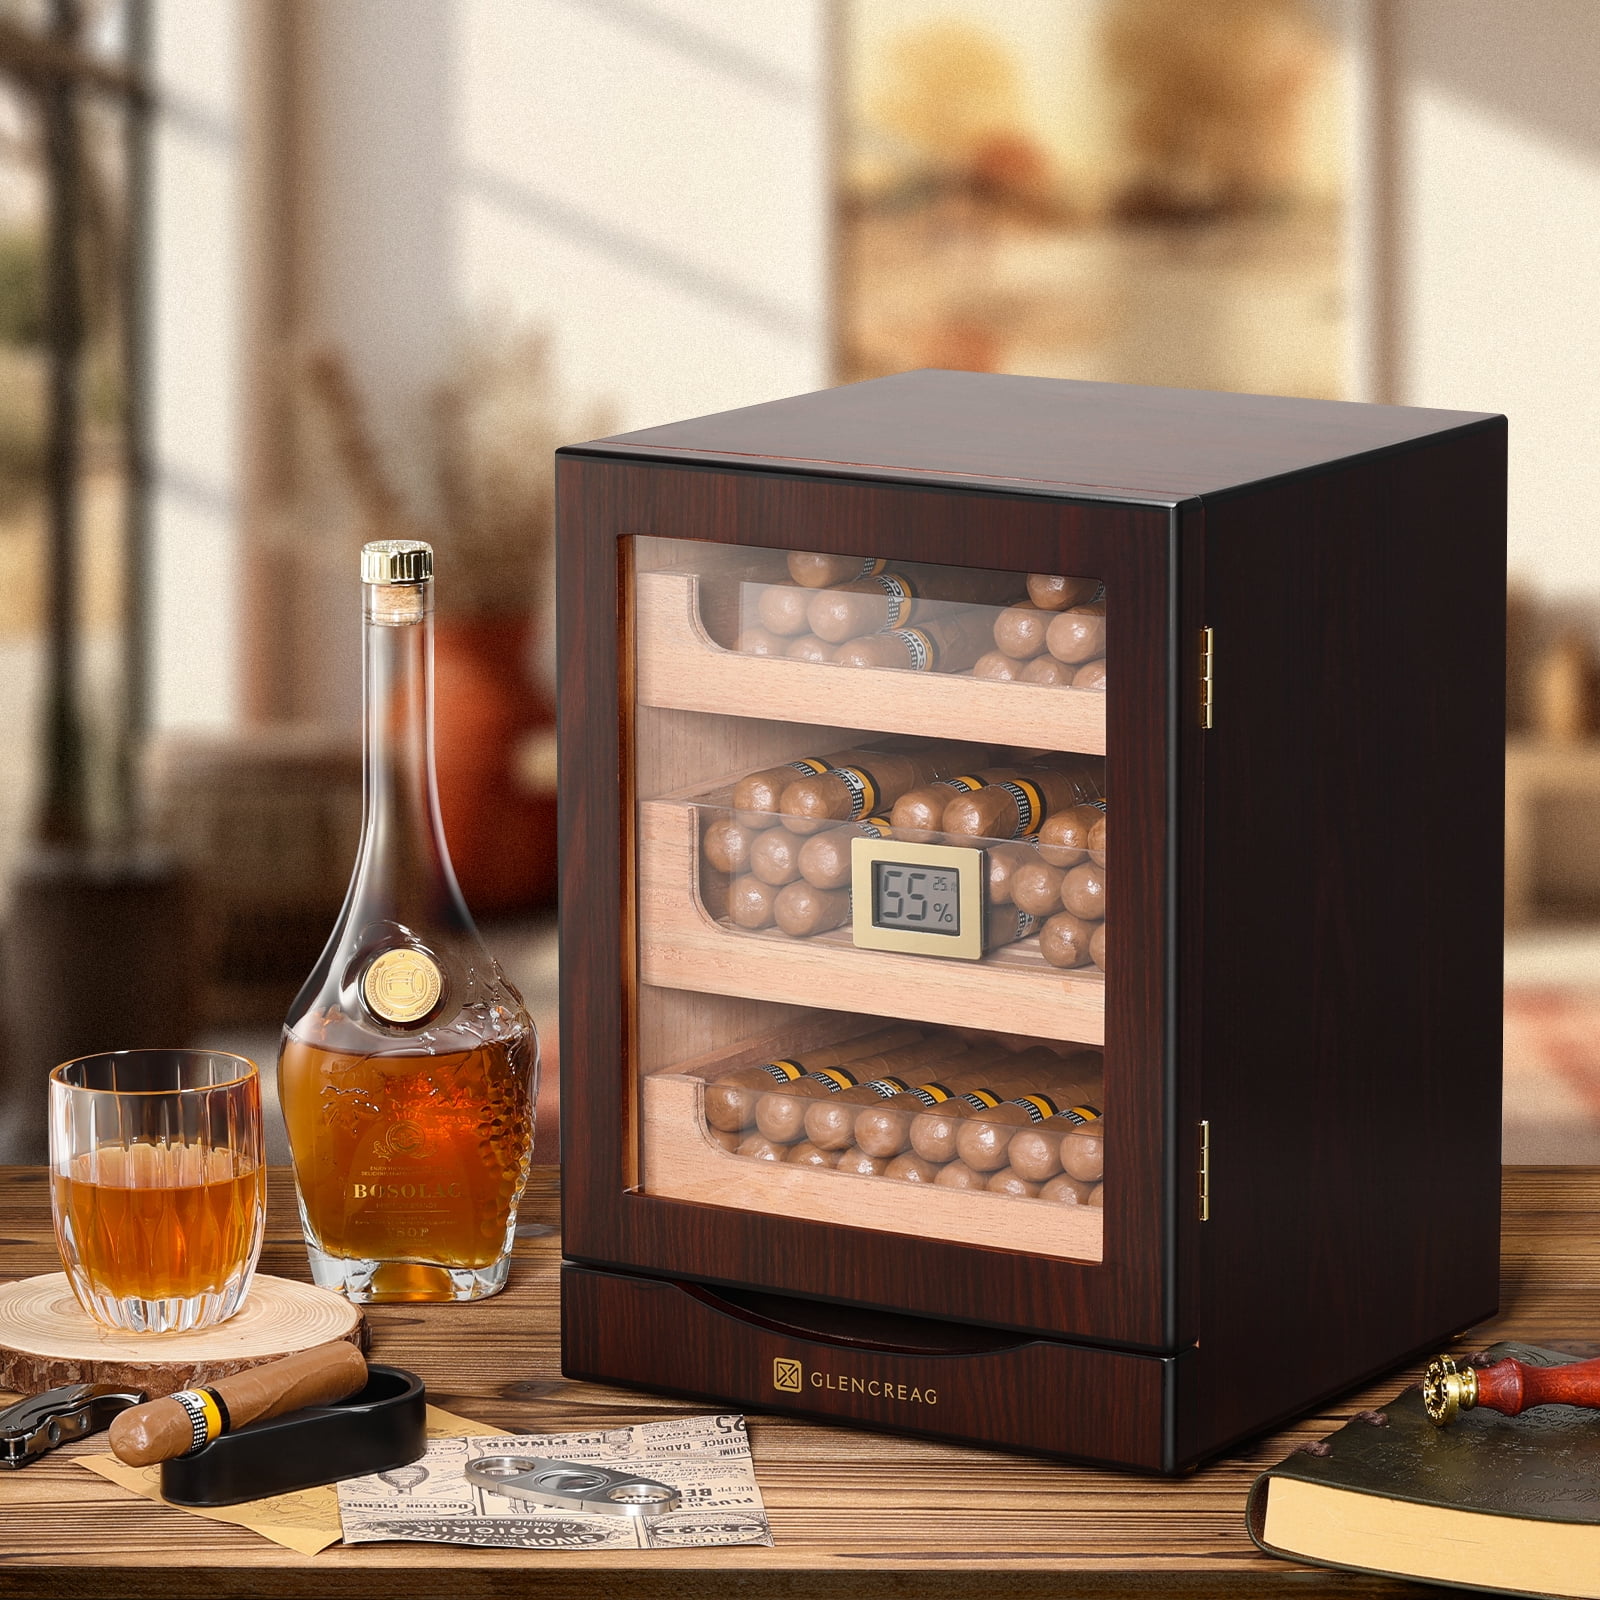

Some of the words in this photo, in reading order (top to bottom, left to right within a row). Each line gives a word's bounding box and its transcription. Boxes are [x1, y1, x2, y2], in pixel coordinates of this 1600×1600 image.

[882, 870, 927, 921] 55
[353, 1182, 463, 1199] BOSOLAC
[810, 1371, 938, 1405] GLENCREAG
[485, 1439, 568, 1448] PINAUD
[701, 1436, 749, 1448] SOURCE
[706, 1498, 755, 1508] PLUS
[401, 1529, 488, 1544] AMIRAL
[417, 1525, 555, 1535] MAIGRIR
[521, 1534, 598, 1547] SAVON
